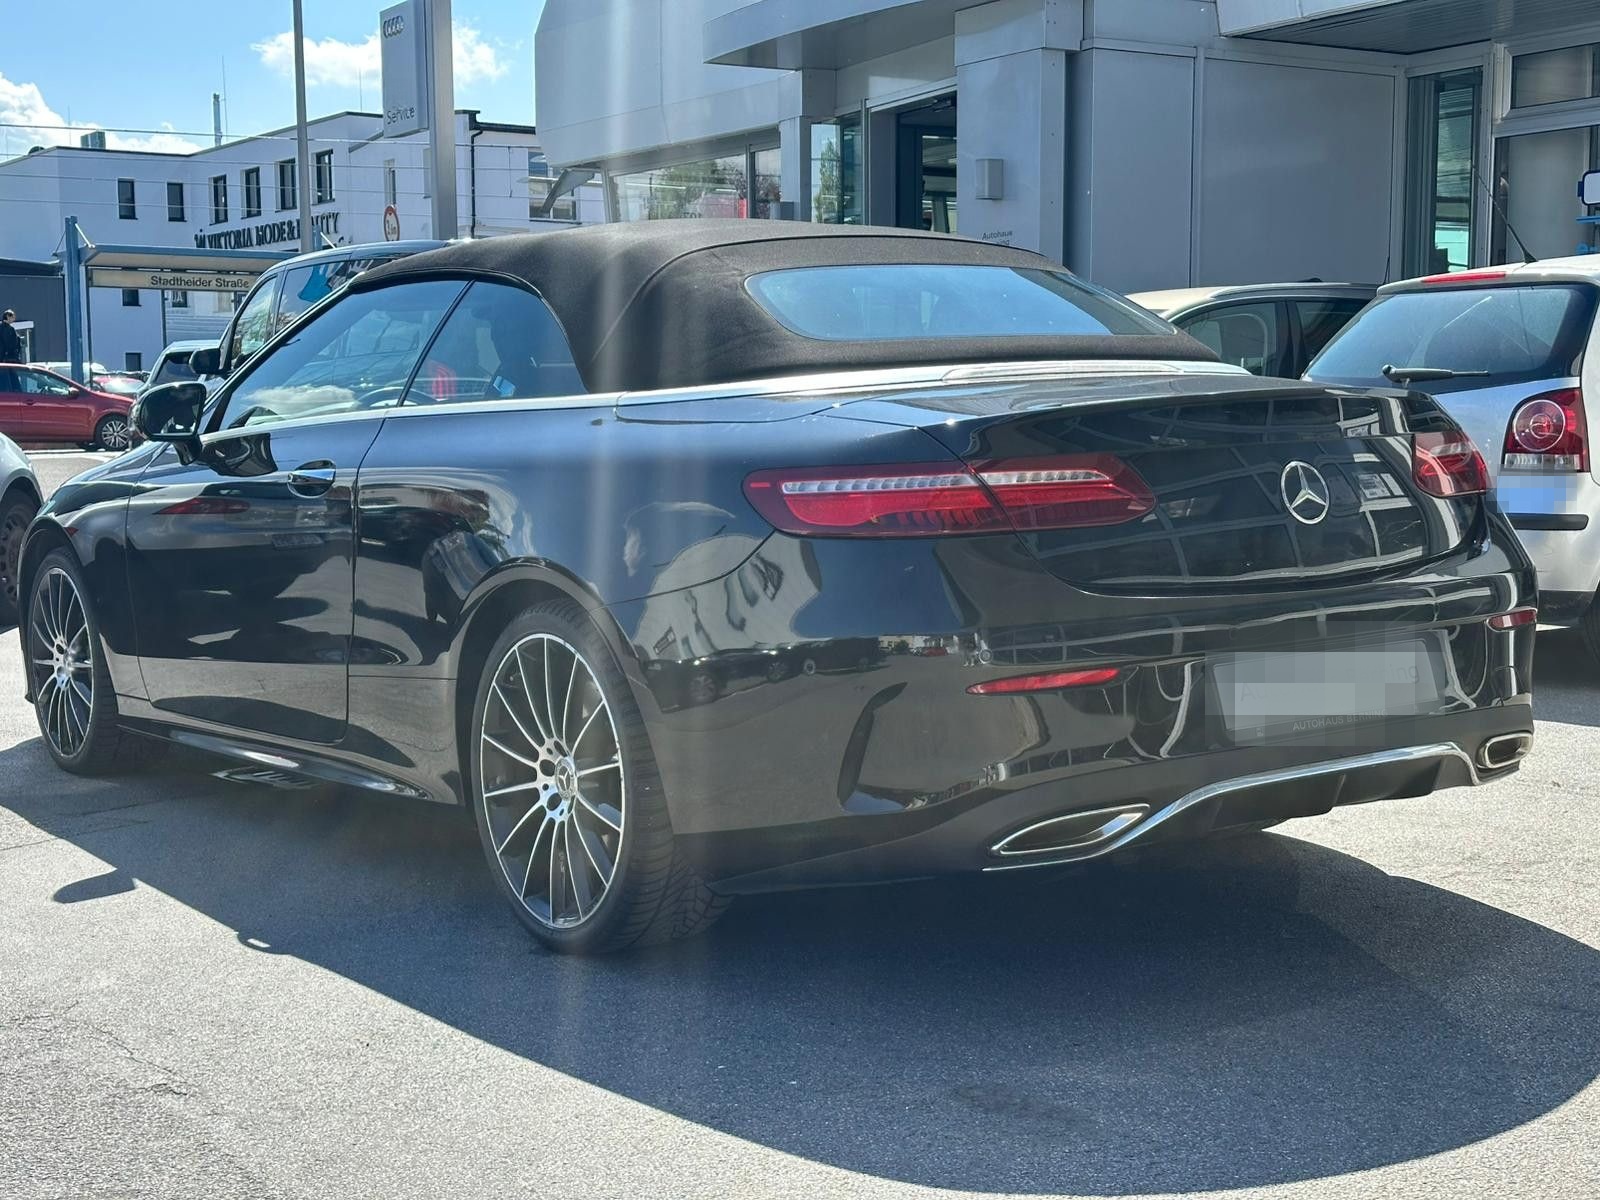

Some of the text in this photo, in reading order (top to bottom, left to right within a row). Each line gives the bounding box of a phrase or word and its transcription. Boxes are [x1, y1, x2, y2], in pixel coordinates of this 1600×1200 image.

[386, 106, 415, 125] Service
[207, 227, 254, 250] VIKTORIA
[255, 220, 286, 247] MODE
[287, 219, 296, 240] &
[981, 230, 1013, 240] Autohaus
[150, 275, 250, 289] Stadtheider Straße
[1292, 715, 1344, 731] AUTOHAUS
